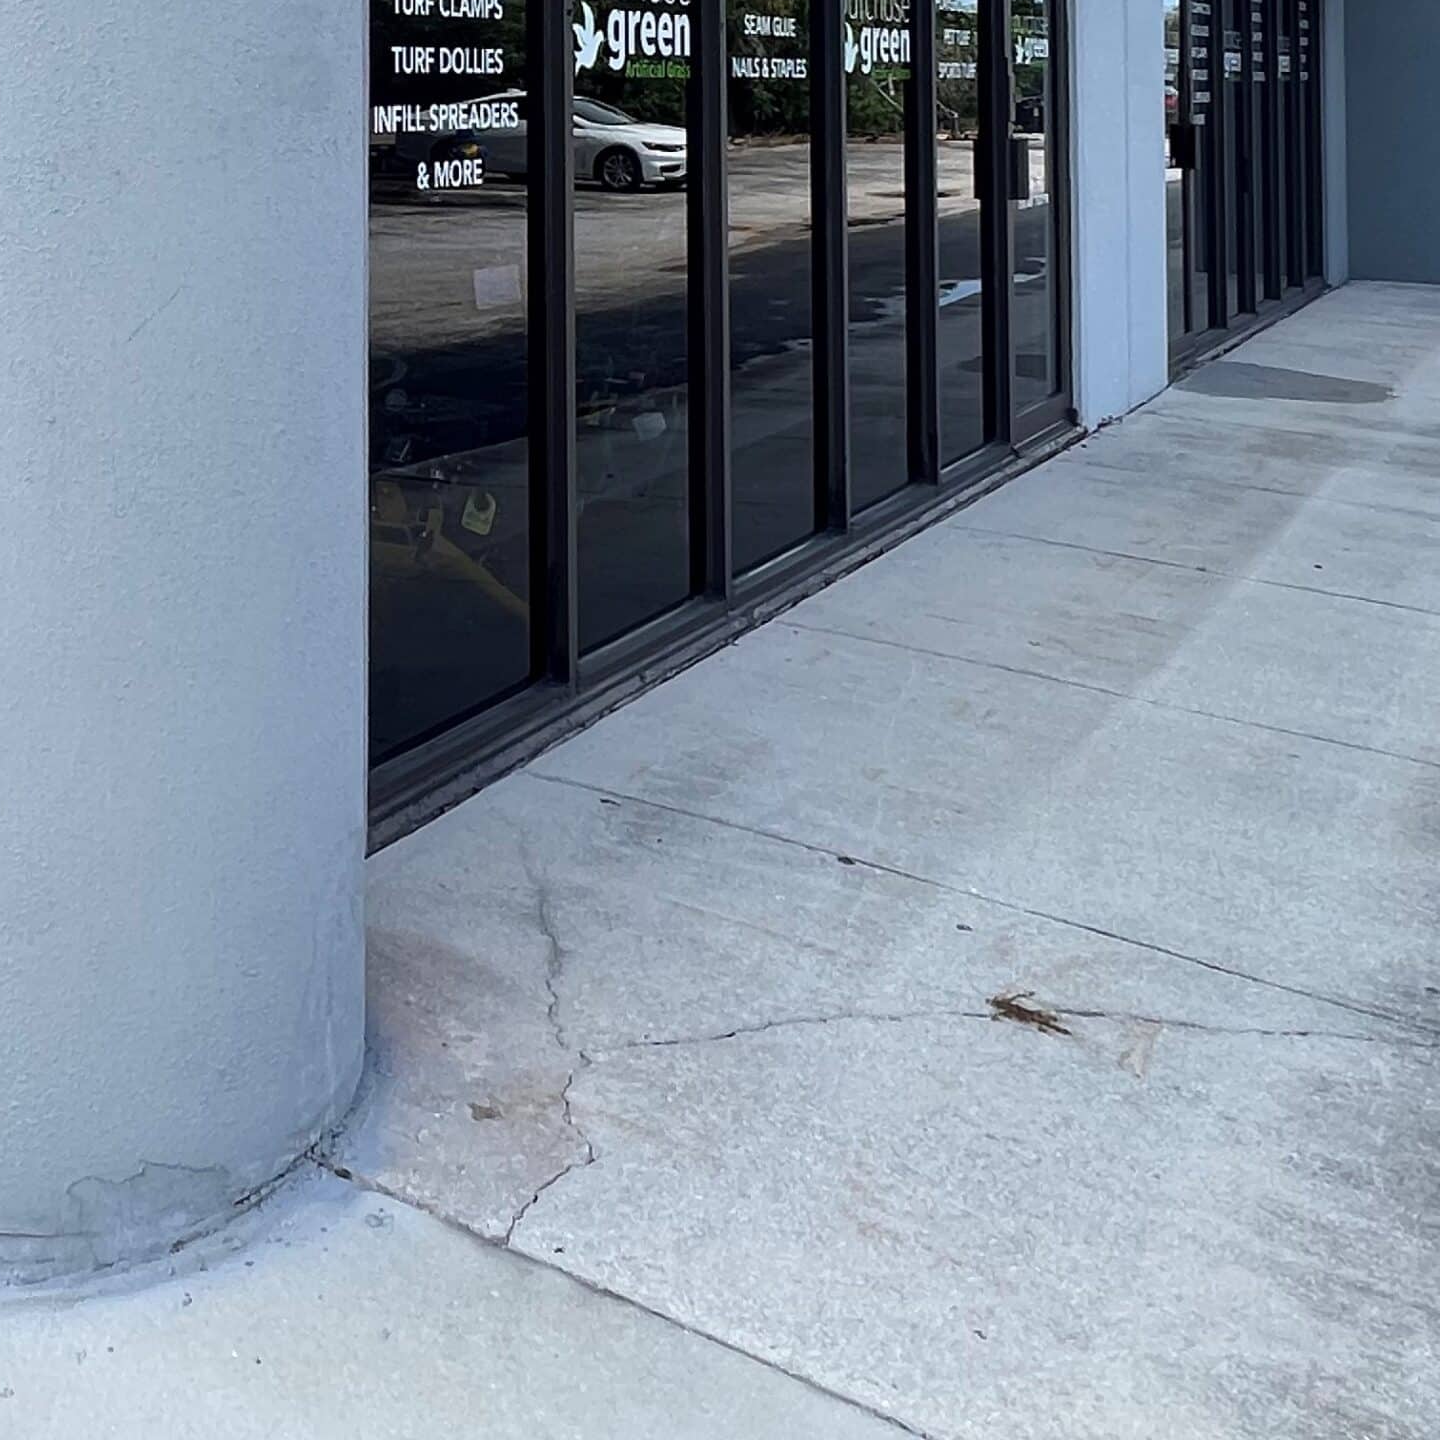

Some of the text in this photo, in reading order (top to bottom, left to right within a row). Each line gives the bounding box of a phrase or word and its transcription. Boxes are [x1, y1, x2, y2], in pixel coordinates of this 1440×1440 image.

[607, 8, 691, 71] green
[860, 27, 911, 75] green
[391, 46, 504, 75] TURF DOLLIES
[731, 56, 760, 78] NAILS
[761, 58, 770, 78] &
[373, 102, 519, 135] INFILL SPREADERS
[416, 159, 484, 190] & MORE
